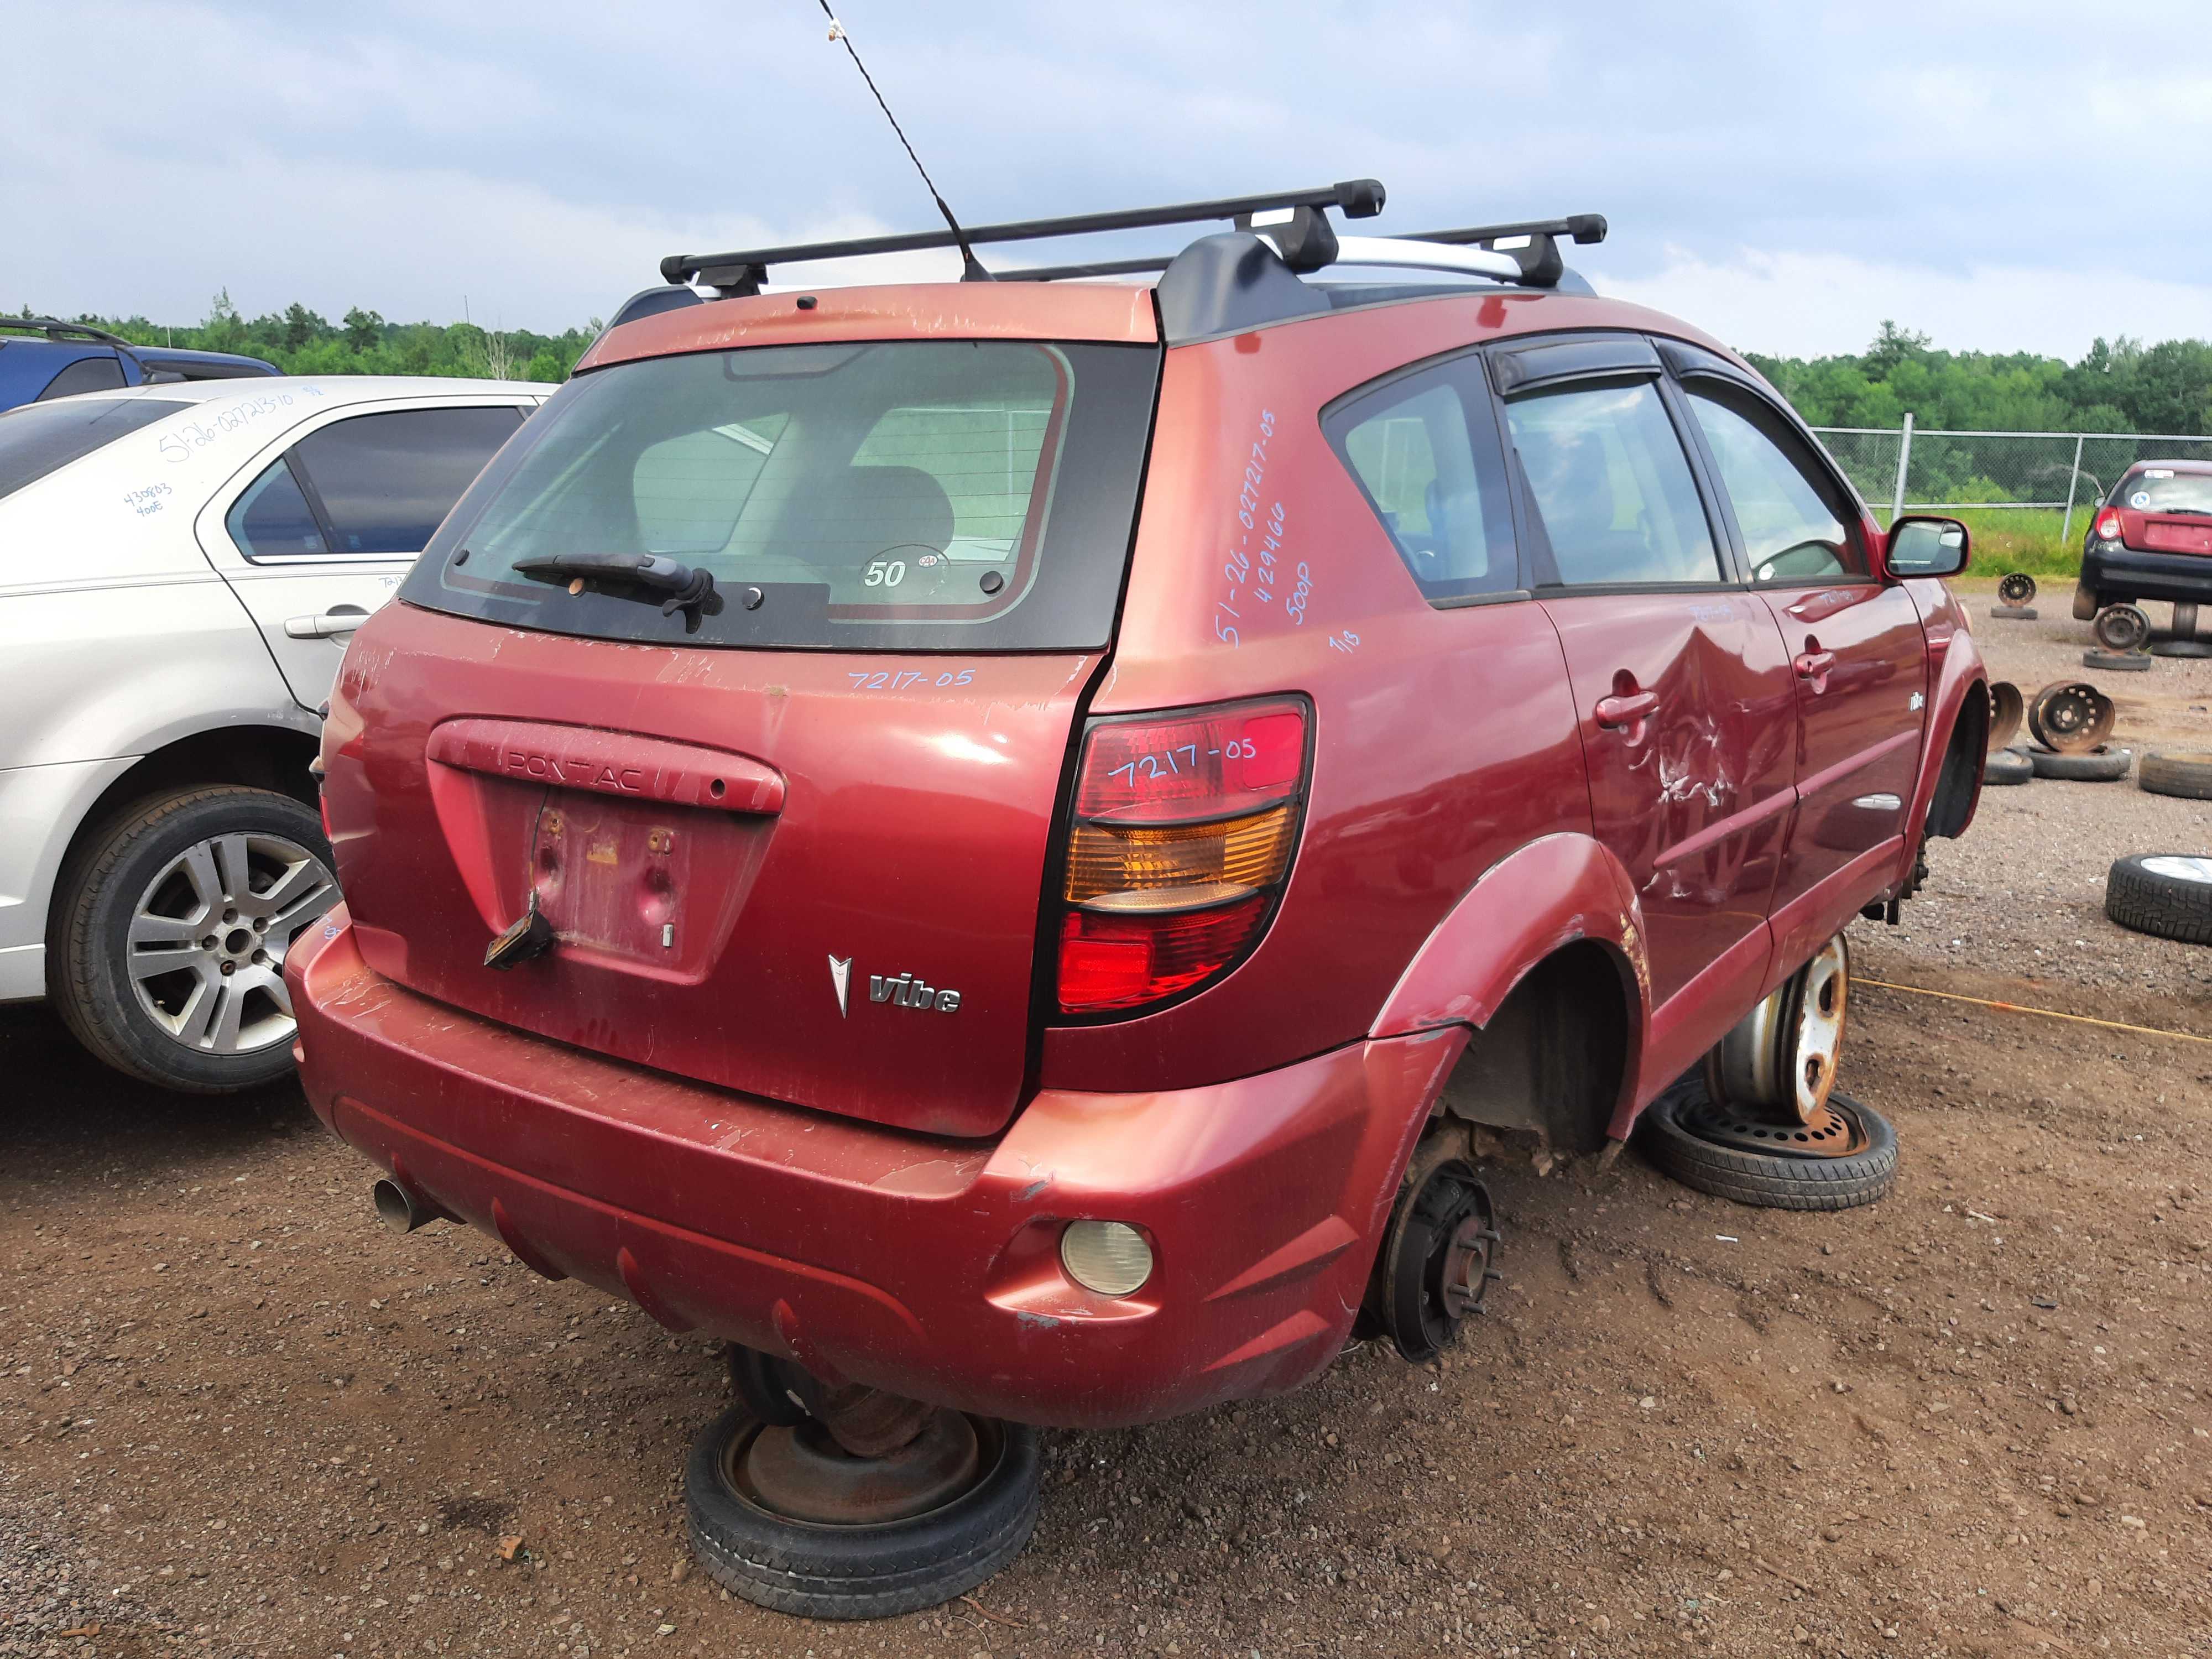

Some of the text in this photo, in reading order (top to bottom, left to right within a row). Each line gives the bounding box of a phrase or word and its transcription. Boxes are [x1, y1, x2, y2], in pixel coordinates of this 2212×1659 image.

[1253, 502, 1285, 603] 429466
[864, 560, 906, 587] 50
[848, 669, 976, 690] 7217-05
[1108, 738, 1256, 787] 7217-05
[870, 973, 960, 1013] vibe
